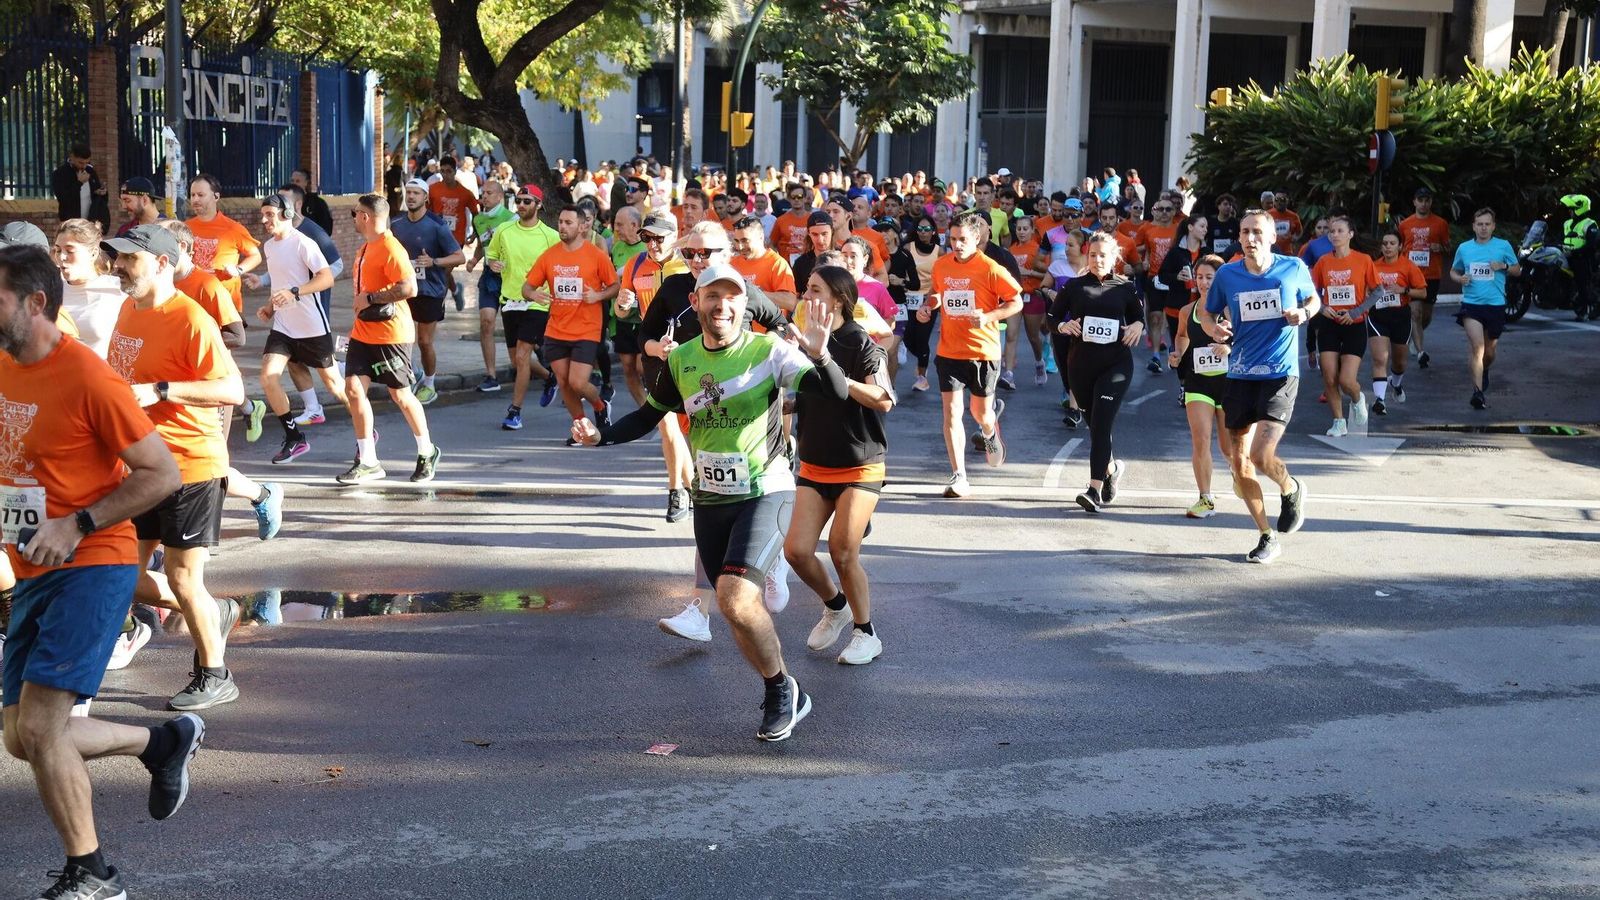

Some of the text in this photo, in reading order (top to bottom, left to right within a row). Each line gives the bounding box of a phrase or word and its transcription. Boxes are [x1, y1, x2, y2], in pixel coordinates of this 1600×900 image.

[557, 284, 577, 294] 664
[1332, 292, 1351, 300] 856
[947, 298, 969, 308] 684
[1245, 299, 1278, 311] 1011
[1088, 325, 1112, 337] 903
[703, 466, 737, 482] 501
[2, 508, 39, 525] 770
